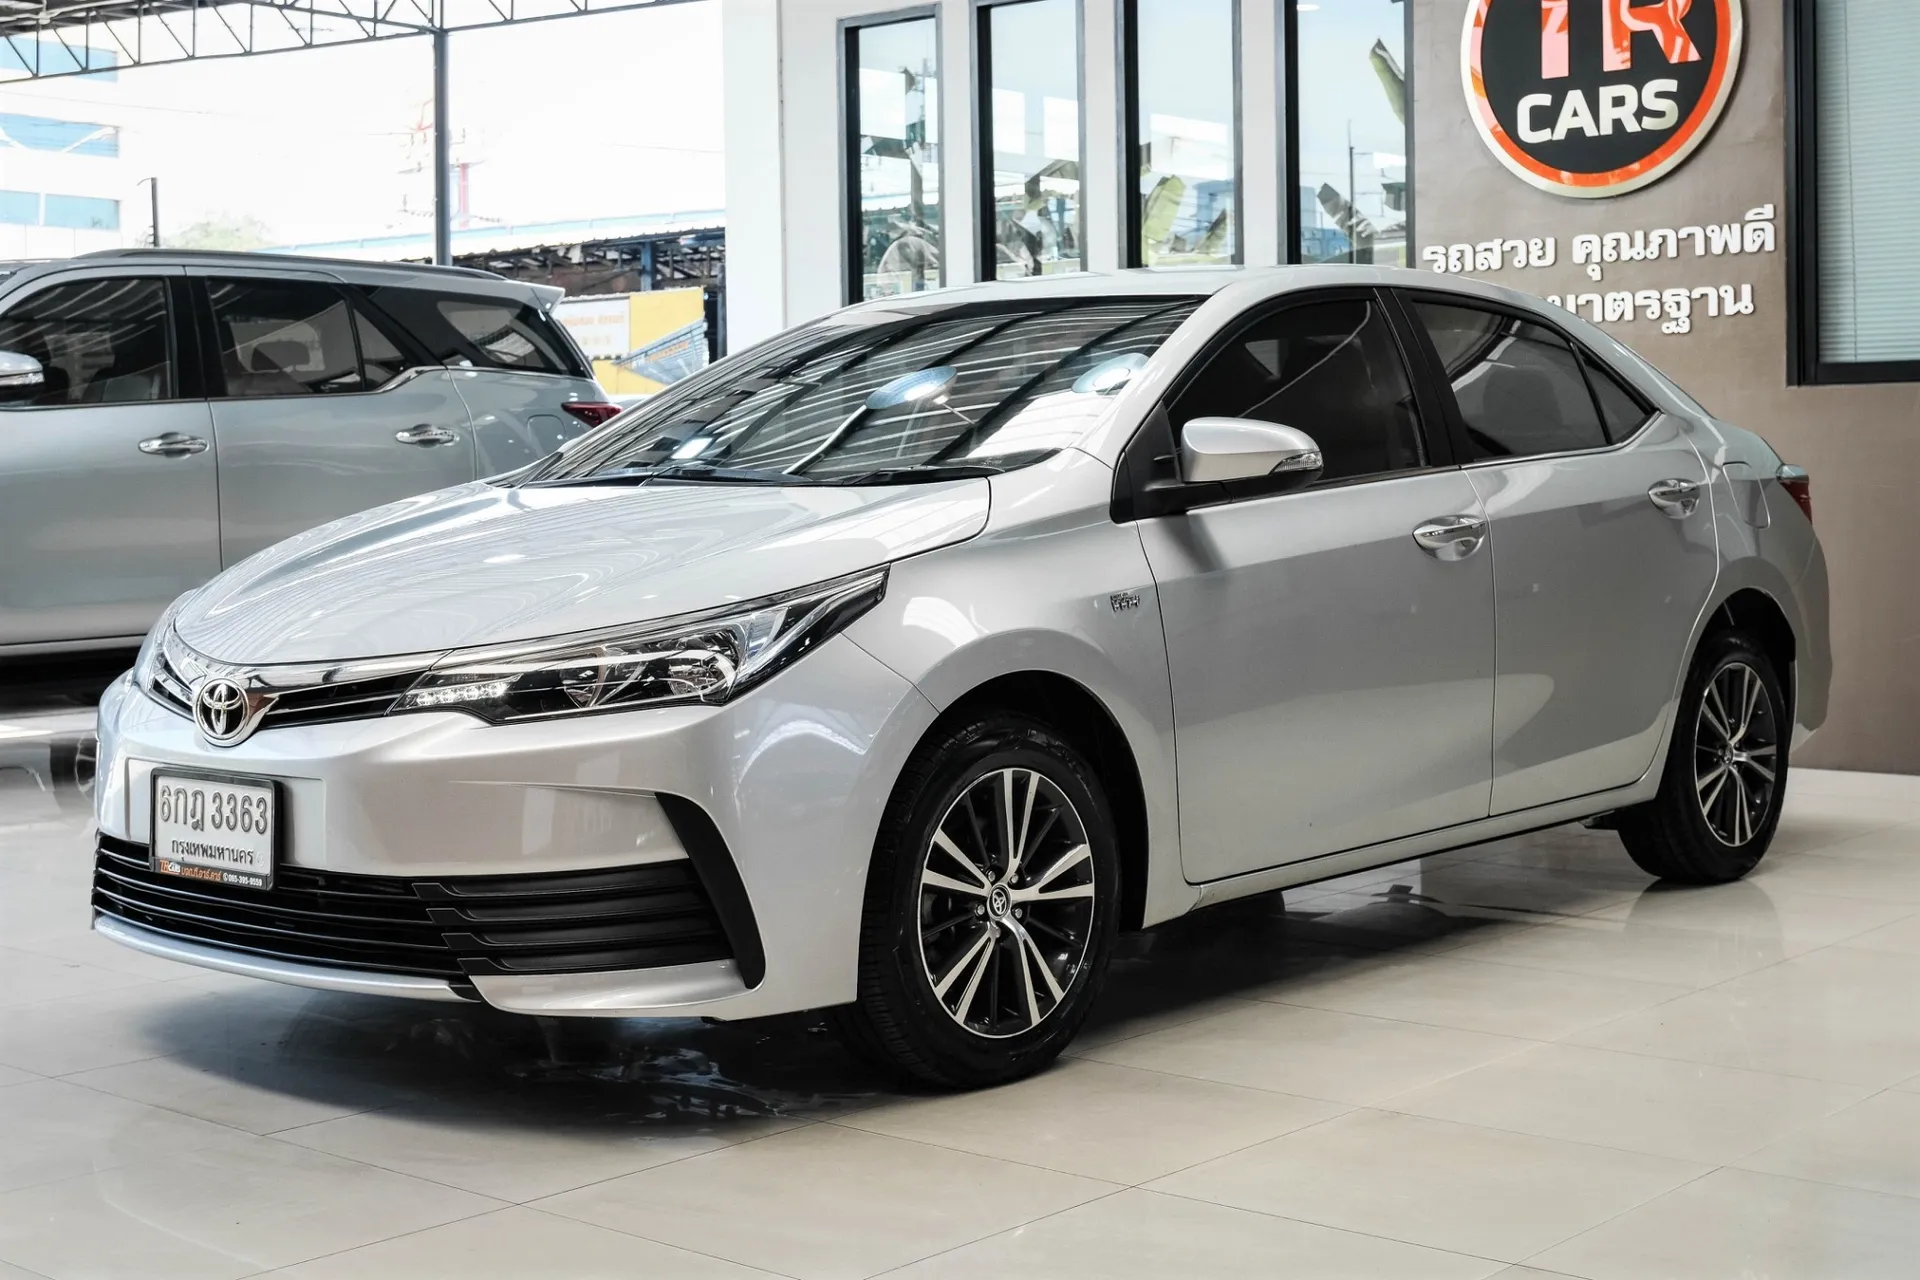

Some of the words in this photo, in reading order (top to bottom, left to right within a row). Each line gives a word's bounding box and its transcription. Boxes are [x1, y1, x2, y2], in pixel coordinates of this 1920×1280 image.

[1517, 79, 1679, 144] CARS
[1422, 236, 1556, 273] รถสวย
[1571, 204, 1775, 281] คุณภาพดี
[160, 785, 205, 831] 6กฎ
[211, 791, 268, 834] 3363
[171, 839, 254, 865] กรุงเทพมหานคร
